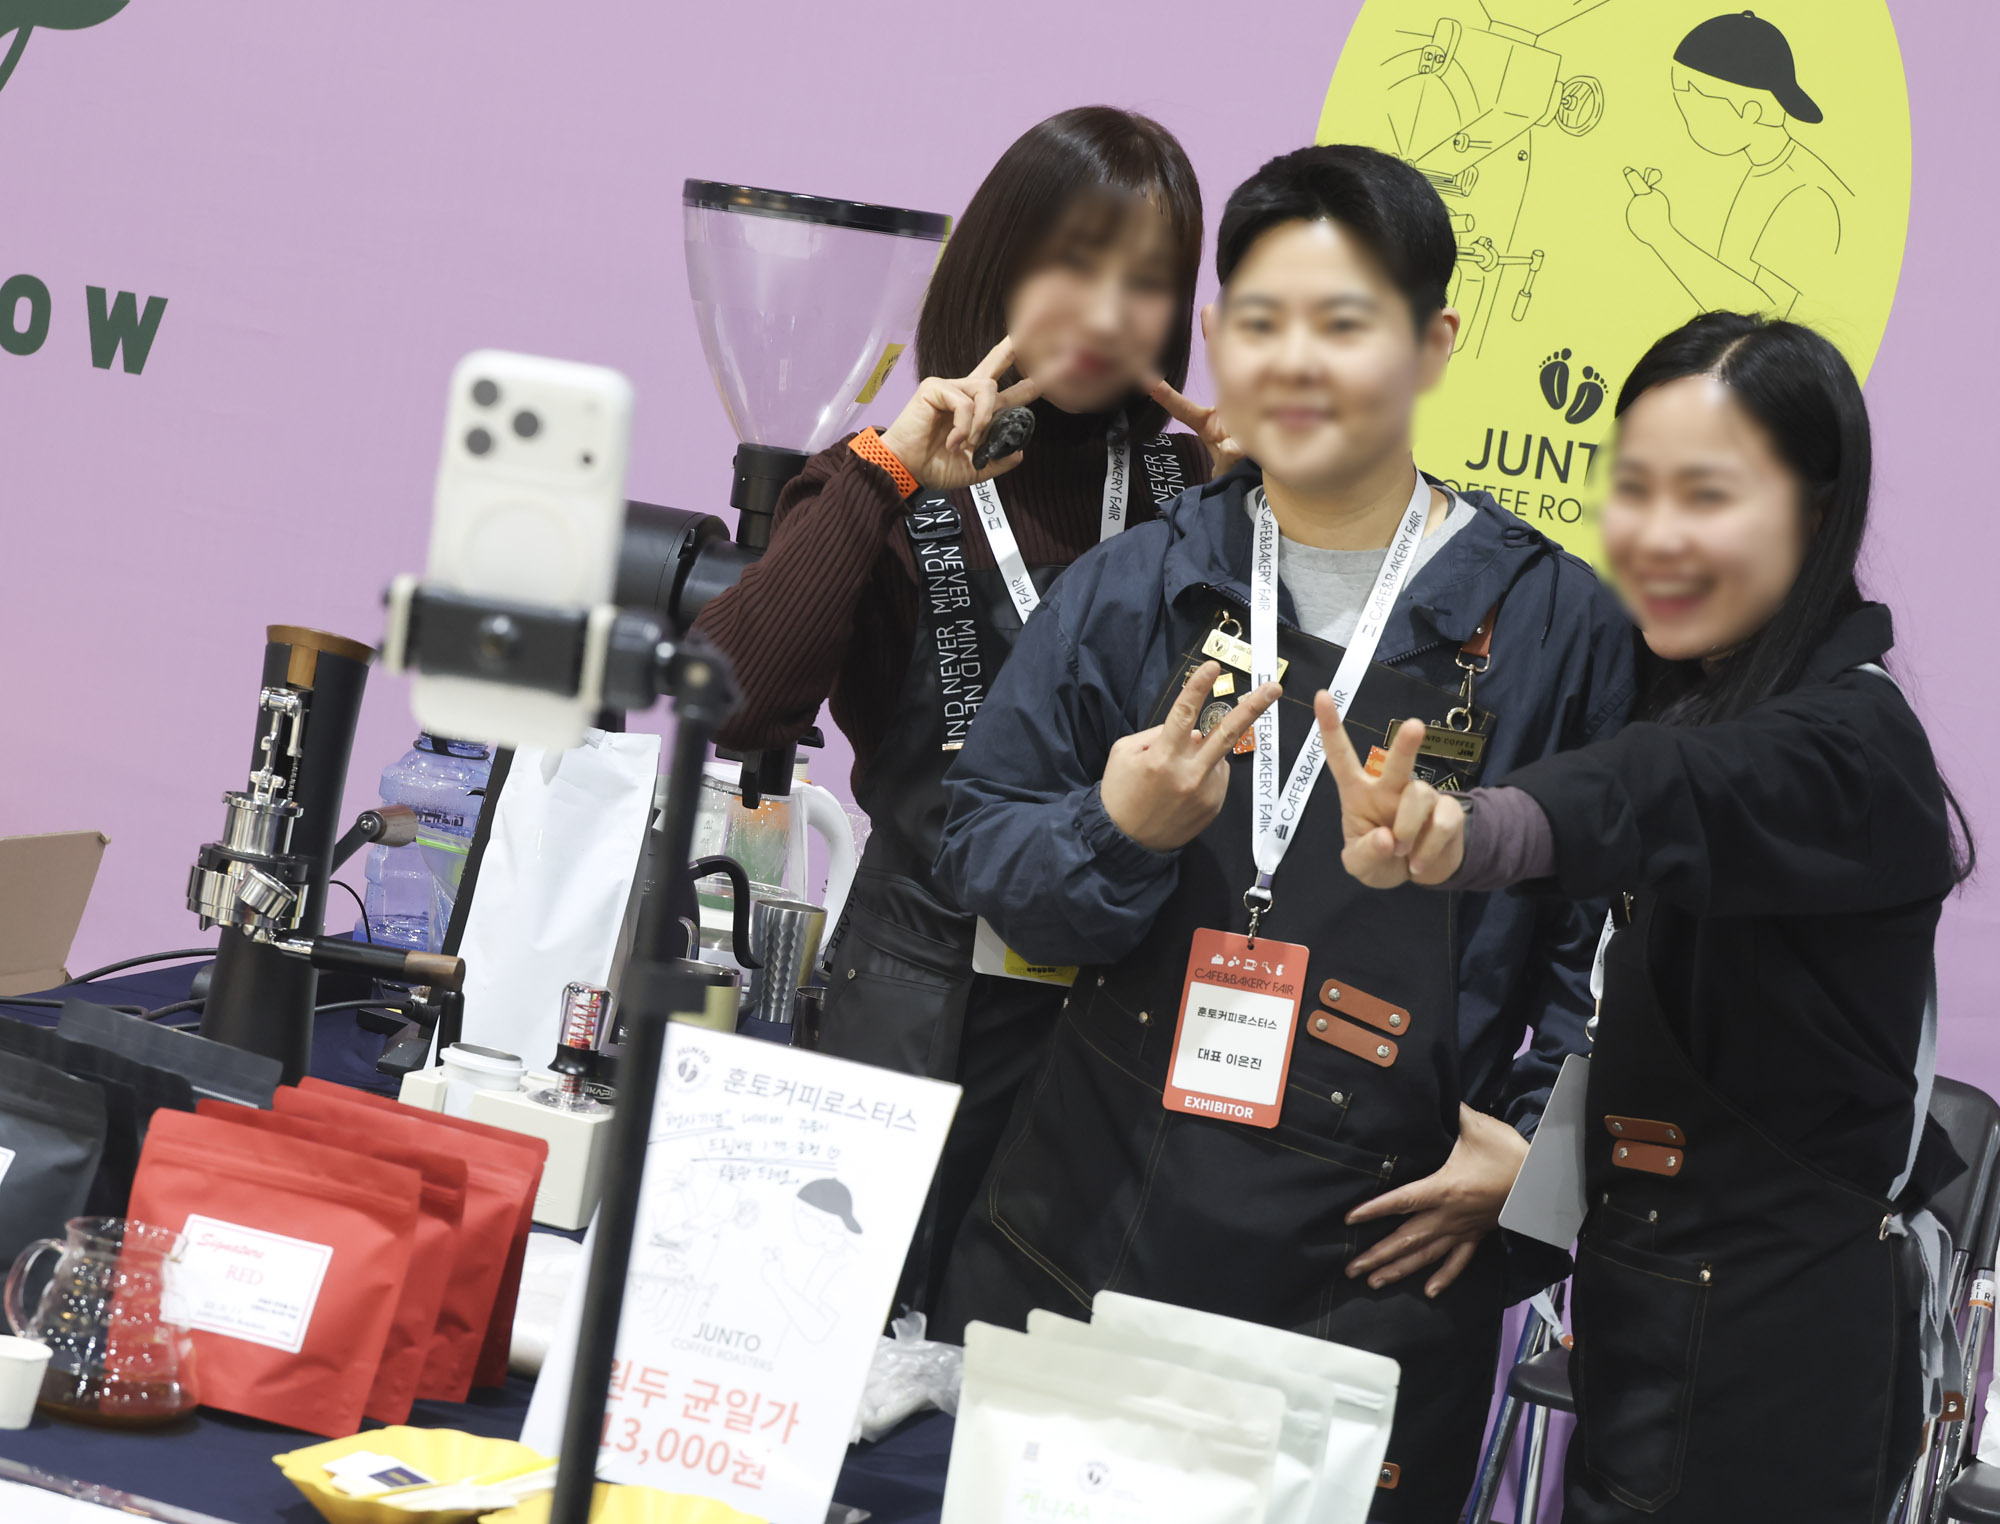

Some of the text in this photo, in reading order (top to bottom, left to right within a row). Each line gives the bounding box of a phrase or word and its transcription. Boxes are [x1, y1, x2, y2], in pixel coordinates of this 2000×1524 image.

[1107, 495, 1122, 521] FAIR
[940, 546, 971, 609] NEVER
[1257, 509, 1274, 612] CAFE&BAKERY FAIR
[1368, 510, 1423, 622] CAFE&BAKERY FAIR
[1011, 576, 1032, 605] FAIR
[936, 625, 963, 695] NEVER
[955, 619, 982, 678] MIND
[1194, 967, 1295, 996] CAFE&BAKERY FAIR
[1197, 1006, 1278, 1031] 훈토커피로스터스
[1197, 1048, 1262, 1071] 대표 이은진
[722, 1066, 918, 1133] 훈토커피로스터스
[1184, 1095, 1255, 1120] EXHIBITOR
[225, 1263, 265, 1287] RED
[670, 1336, 774, 1373] COFFEE ROASTERS
[691, 1322, 762, 1353] JUNTO
[681, 1378, 800, 1445] 균일가
[600, 1411, 767, 1491] 13,000원
